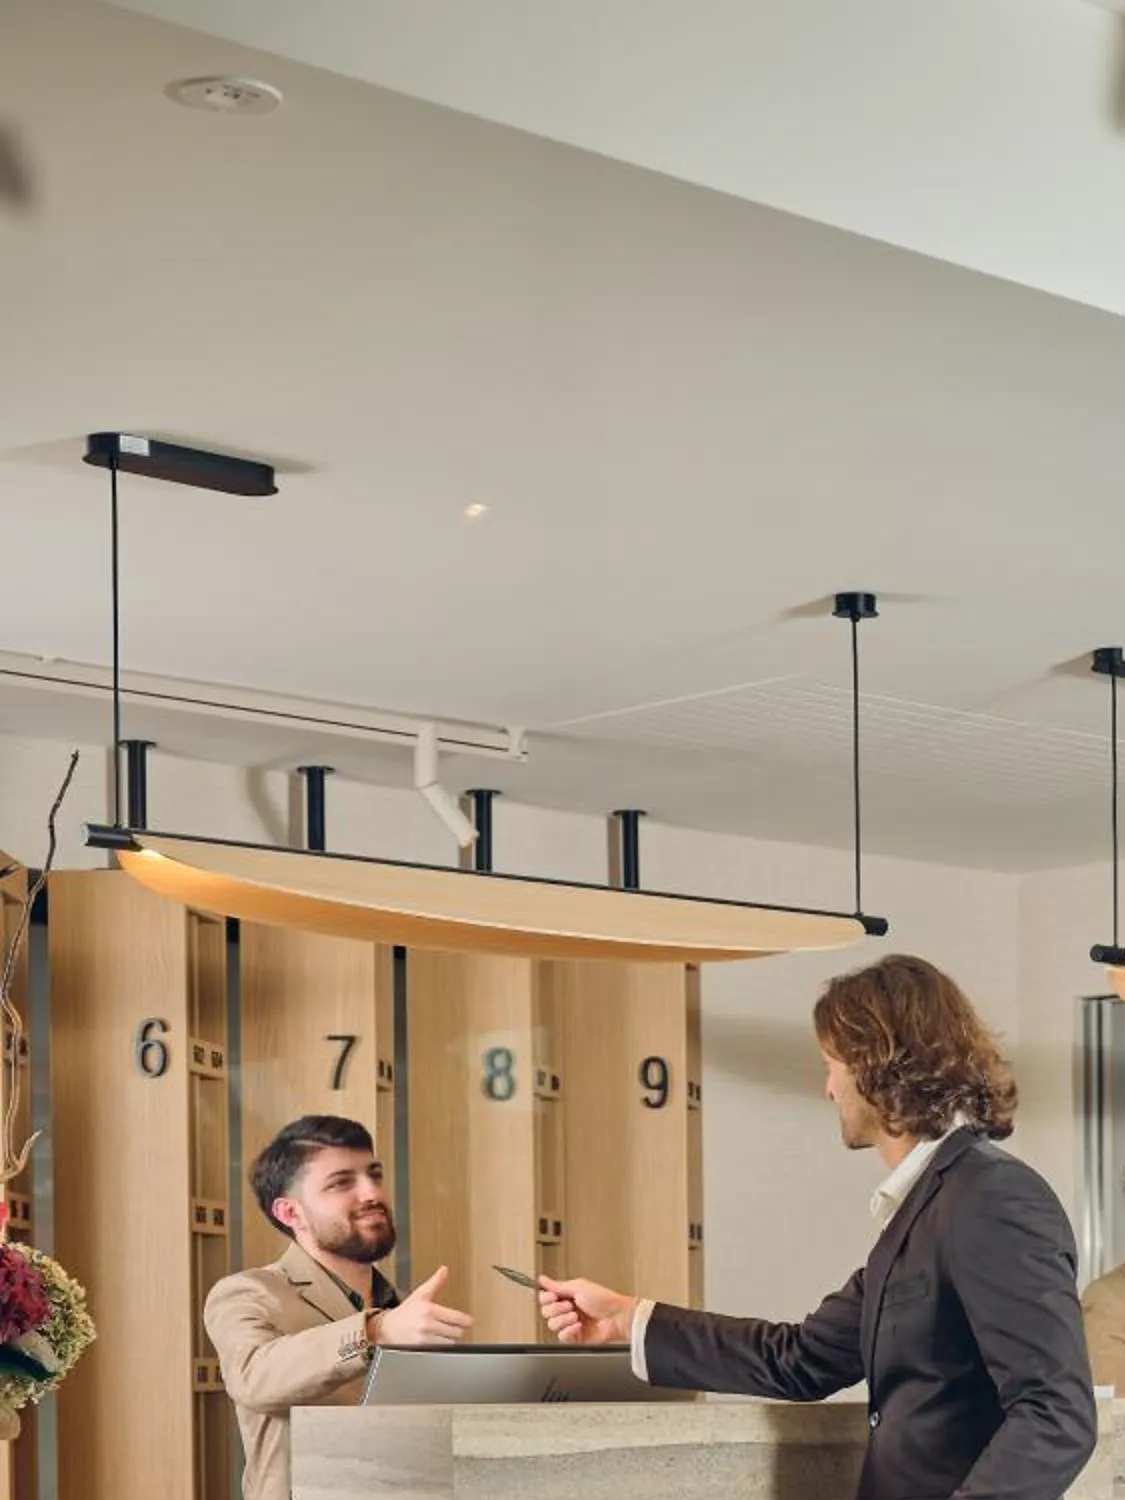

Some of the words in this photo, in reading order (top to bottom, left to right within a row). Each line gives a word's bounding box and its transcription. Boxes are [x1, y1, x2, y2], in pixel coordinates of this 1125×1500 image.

[136, 1018, 169, 1078] 6
[326, 1035, 357, 1091] 7
[483, 1047, 515, 1102] 8
[640, 1056, 669, 1109] 9
